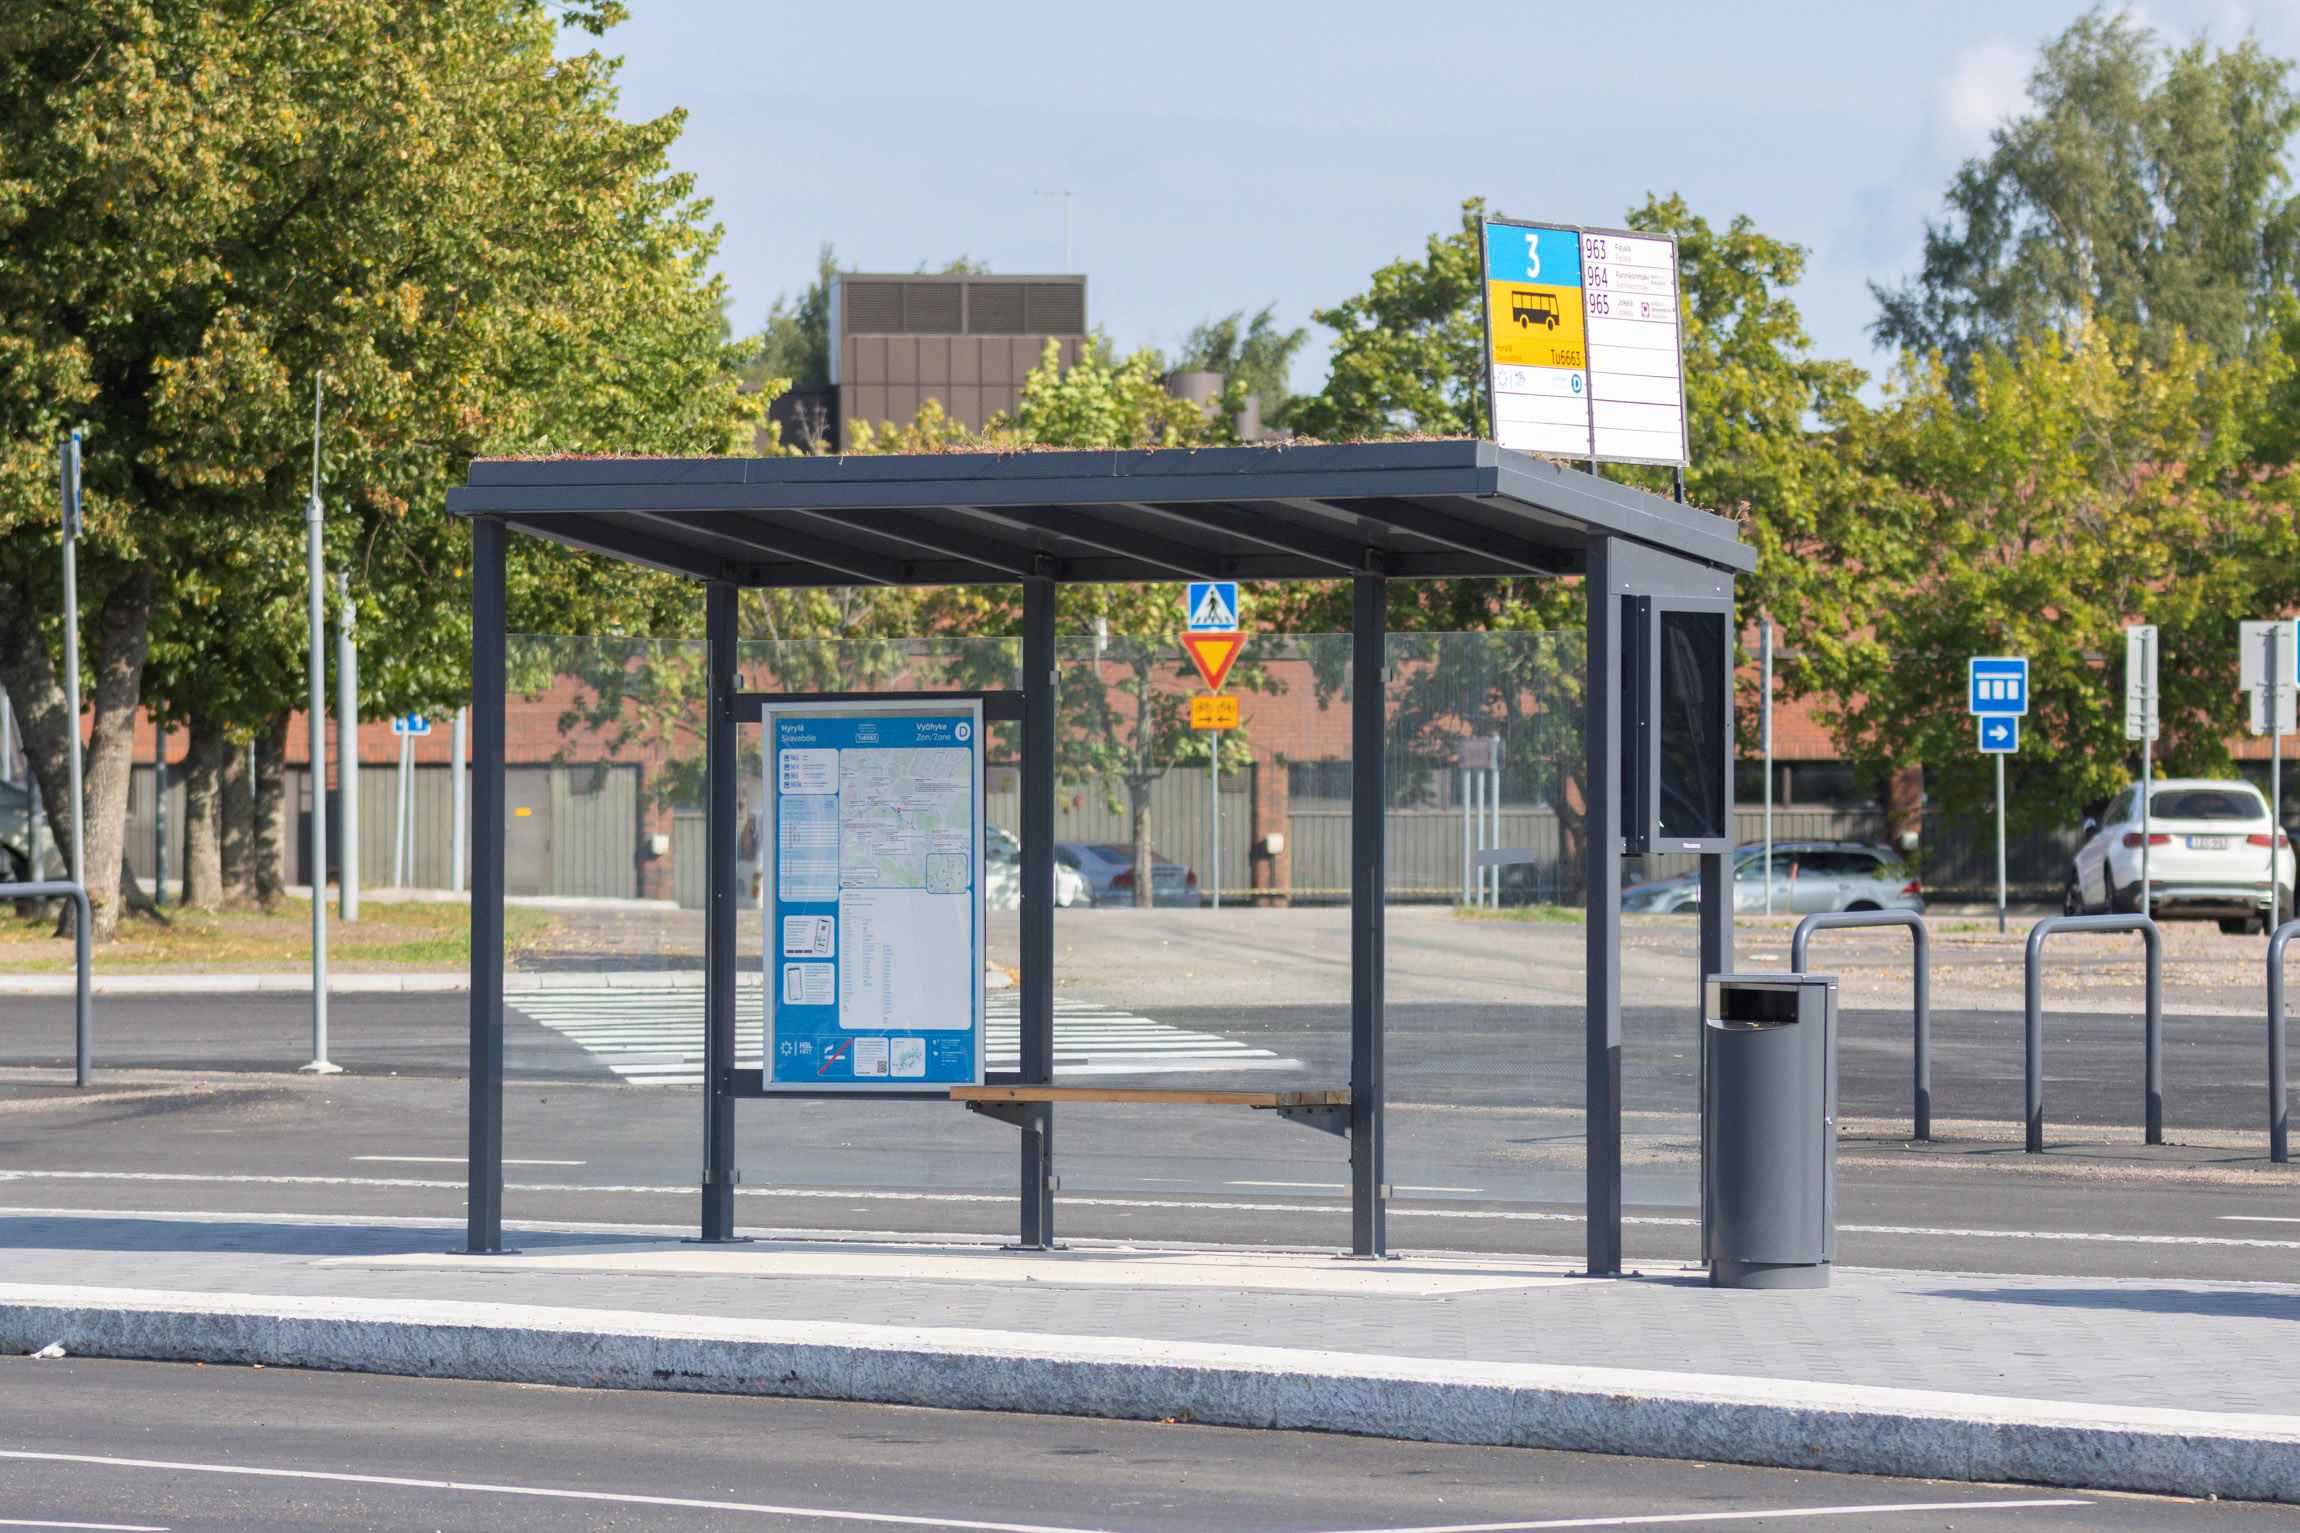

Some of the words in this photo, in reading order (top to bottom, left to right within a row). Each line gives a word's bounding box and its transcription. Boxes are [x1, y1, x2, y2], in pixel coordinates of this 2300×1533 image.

[1525, 234, 1541, 279] 3
[1585, 237, 1606, 260] 963
[1587, 265, 1608, 287] 964
[1589, 292, 1610, 315] 965
[1550, 348, 1582, 367] Tu6663
[959, 725, 968, 738] D
